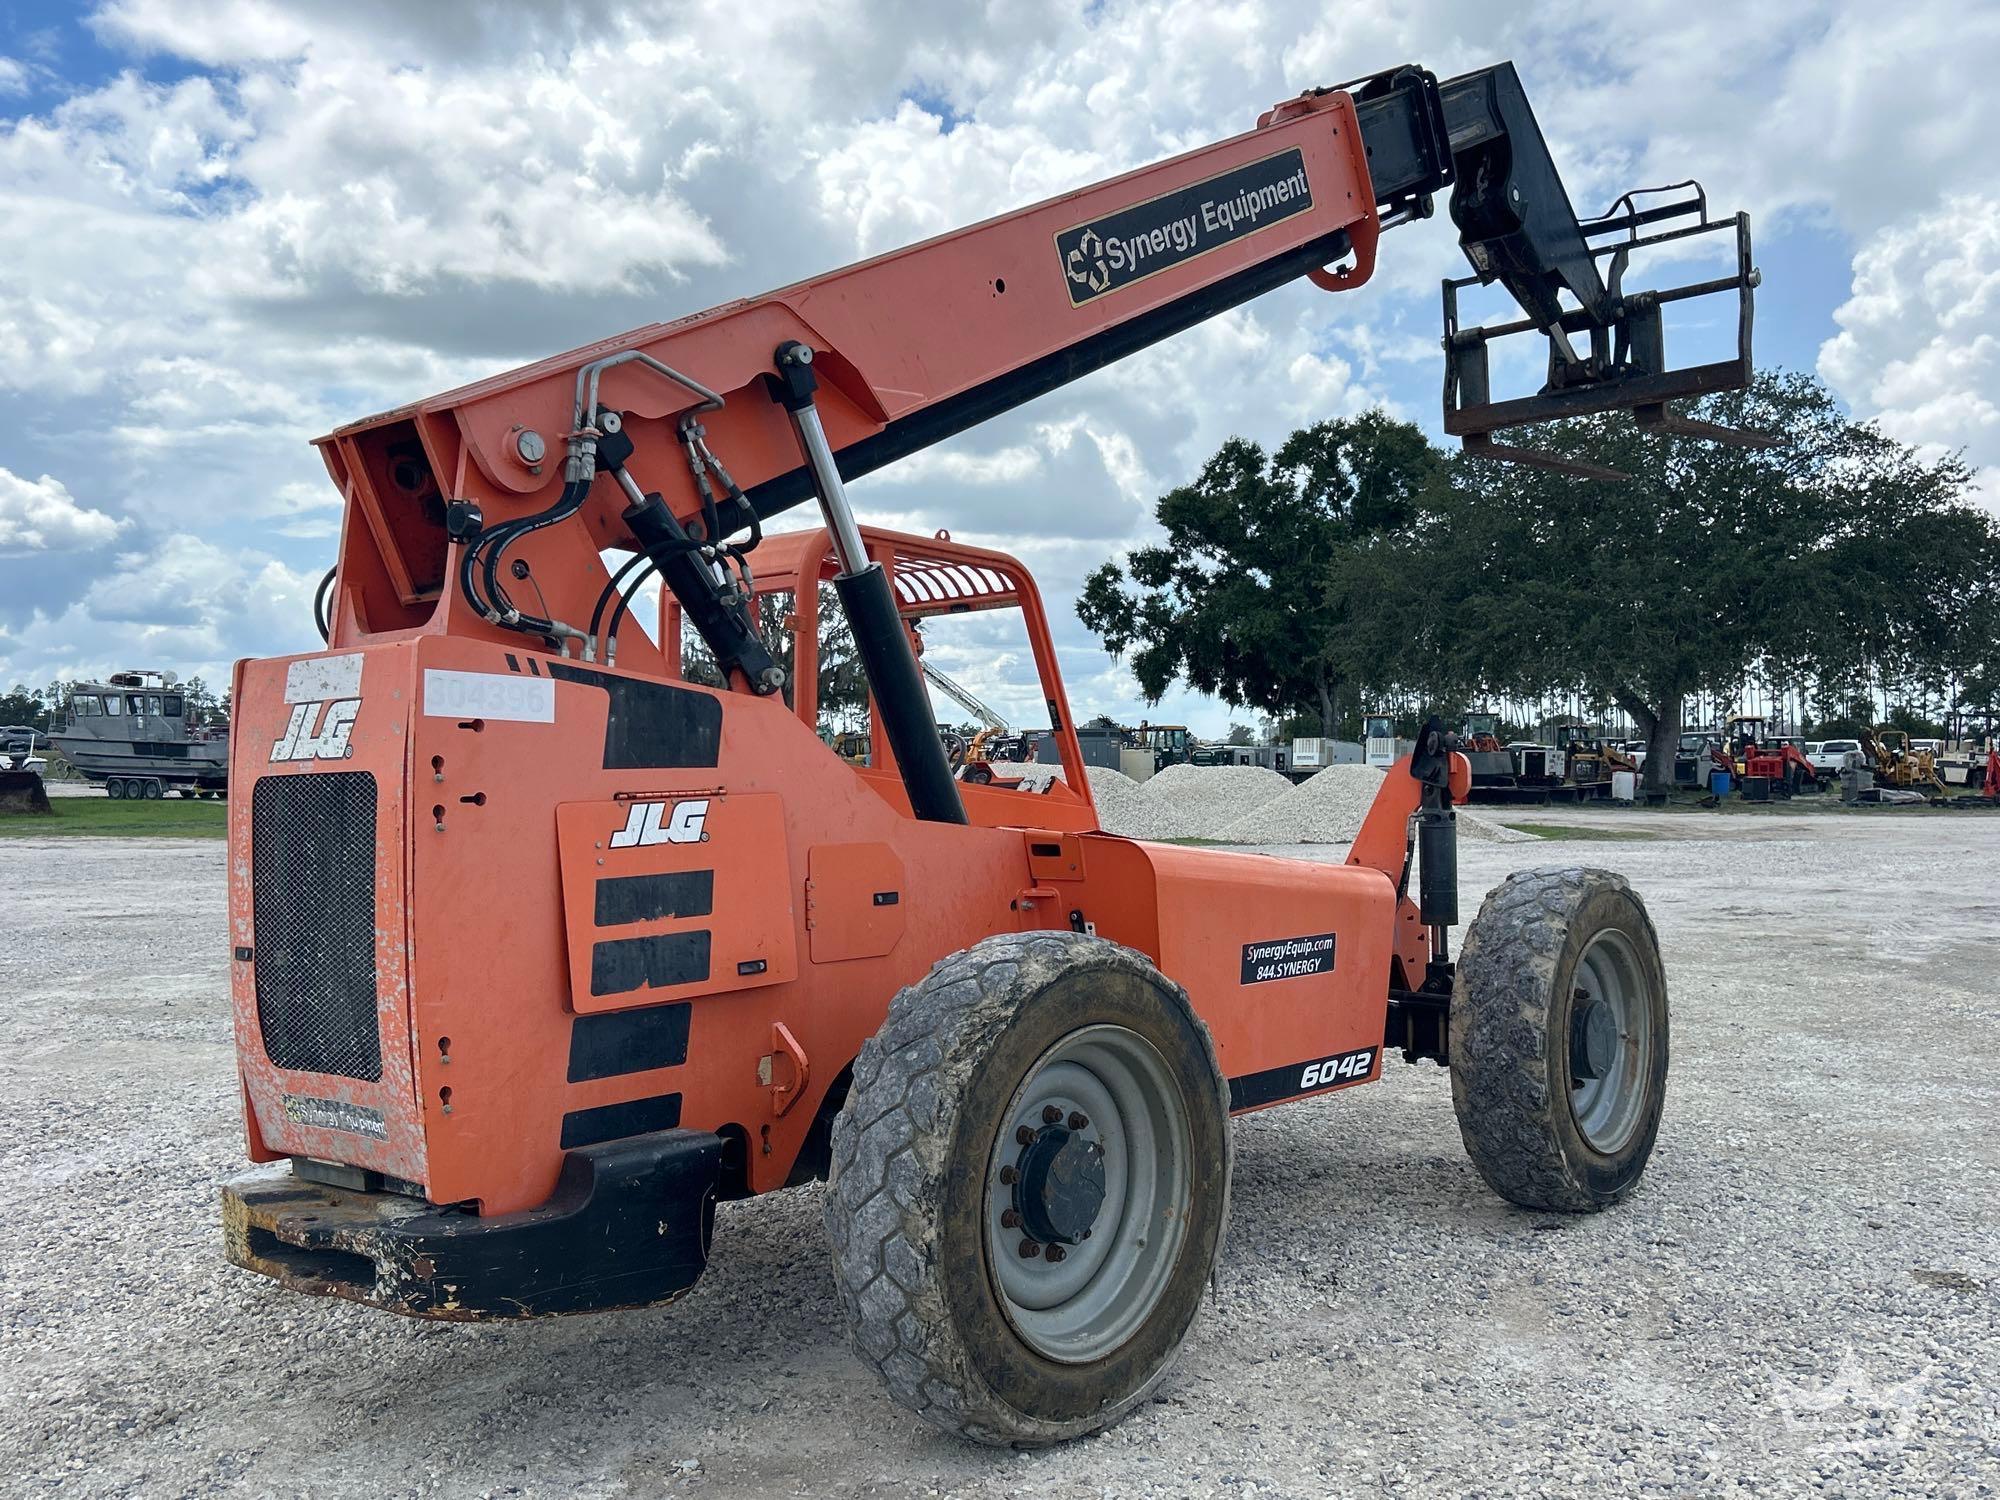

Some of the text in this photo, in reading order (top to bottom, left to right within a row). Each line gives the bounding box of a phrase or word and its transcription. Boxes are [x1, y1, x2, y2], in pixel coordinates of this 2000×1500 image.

[1106, 168, 1308, 272] Synergy Equipment
[268, 698, 362, 762] JLG
[608, 799, 710, 849] JLG
[1247, 938, 1333, 963] SynergyEquip.com
[1256, 958, 1322, 980] 844.SYNERGY
[1300, 1052, 1371, 1088] 6042
[300, 1104, 387, 1135] Sngy qupment
